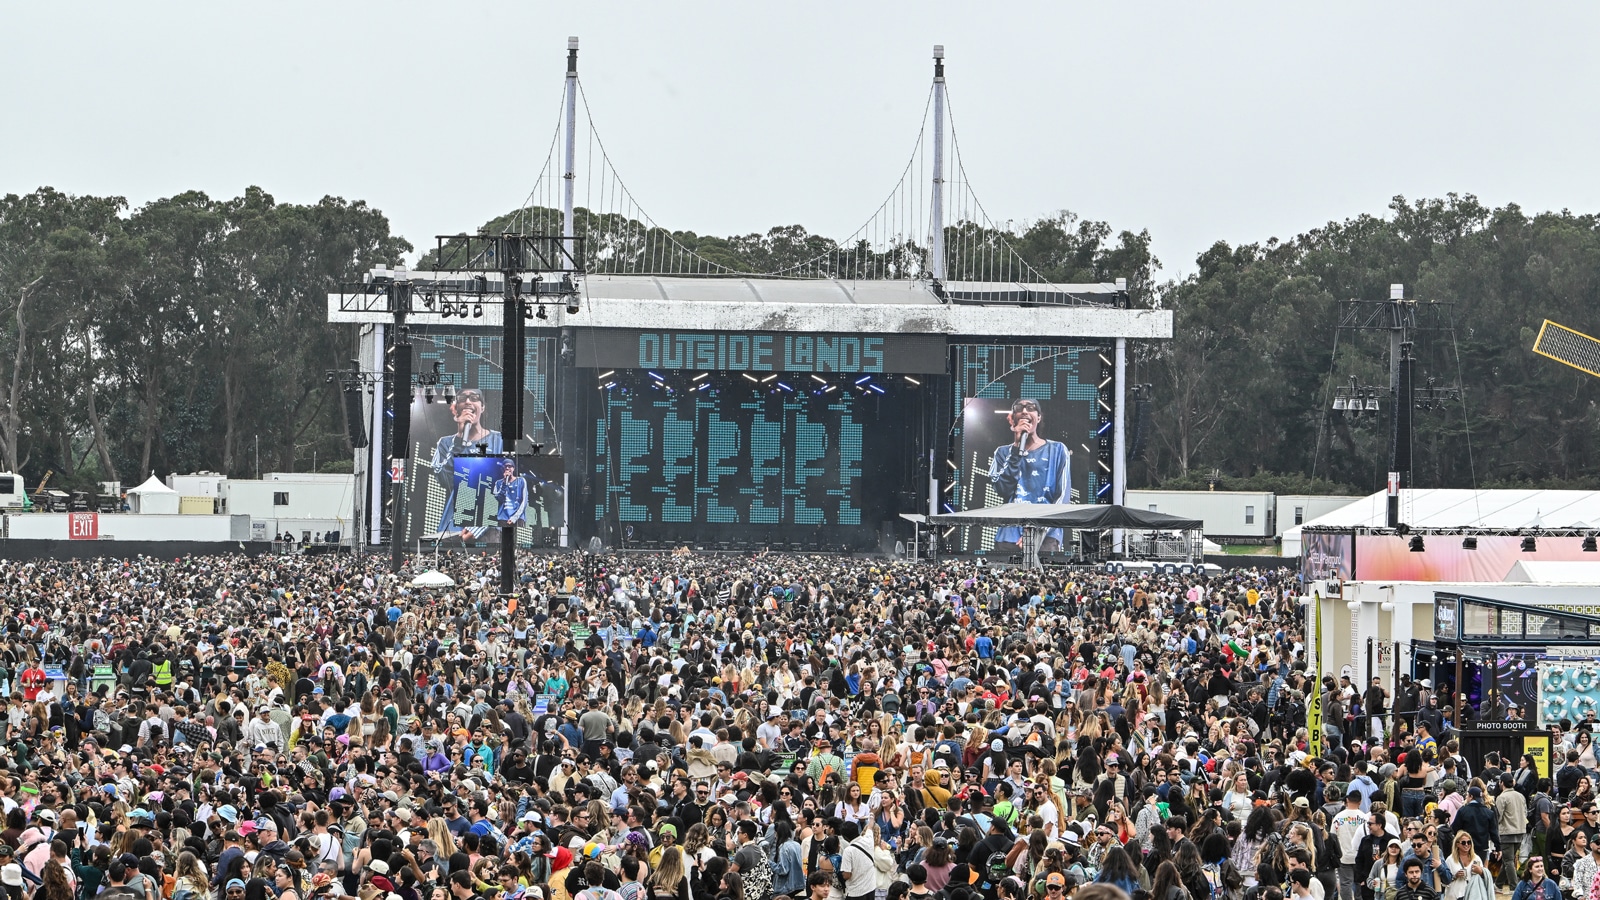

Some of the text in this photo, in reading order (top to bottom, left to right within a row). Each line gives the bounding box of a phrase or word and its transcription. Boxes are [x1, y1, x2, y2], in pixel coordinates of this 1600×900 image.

[639, 333, 884, 373] OUTSIDE LANDS
[392, 467, 399, 480] 2
[73, 520, 93, 536] EXIT
